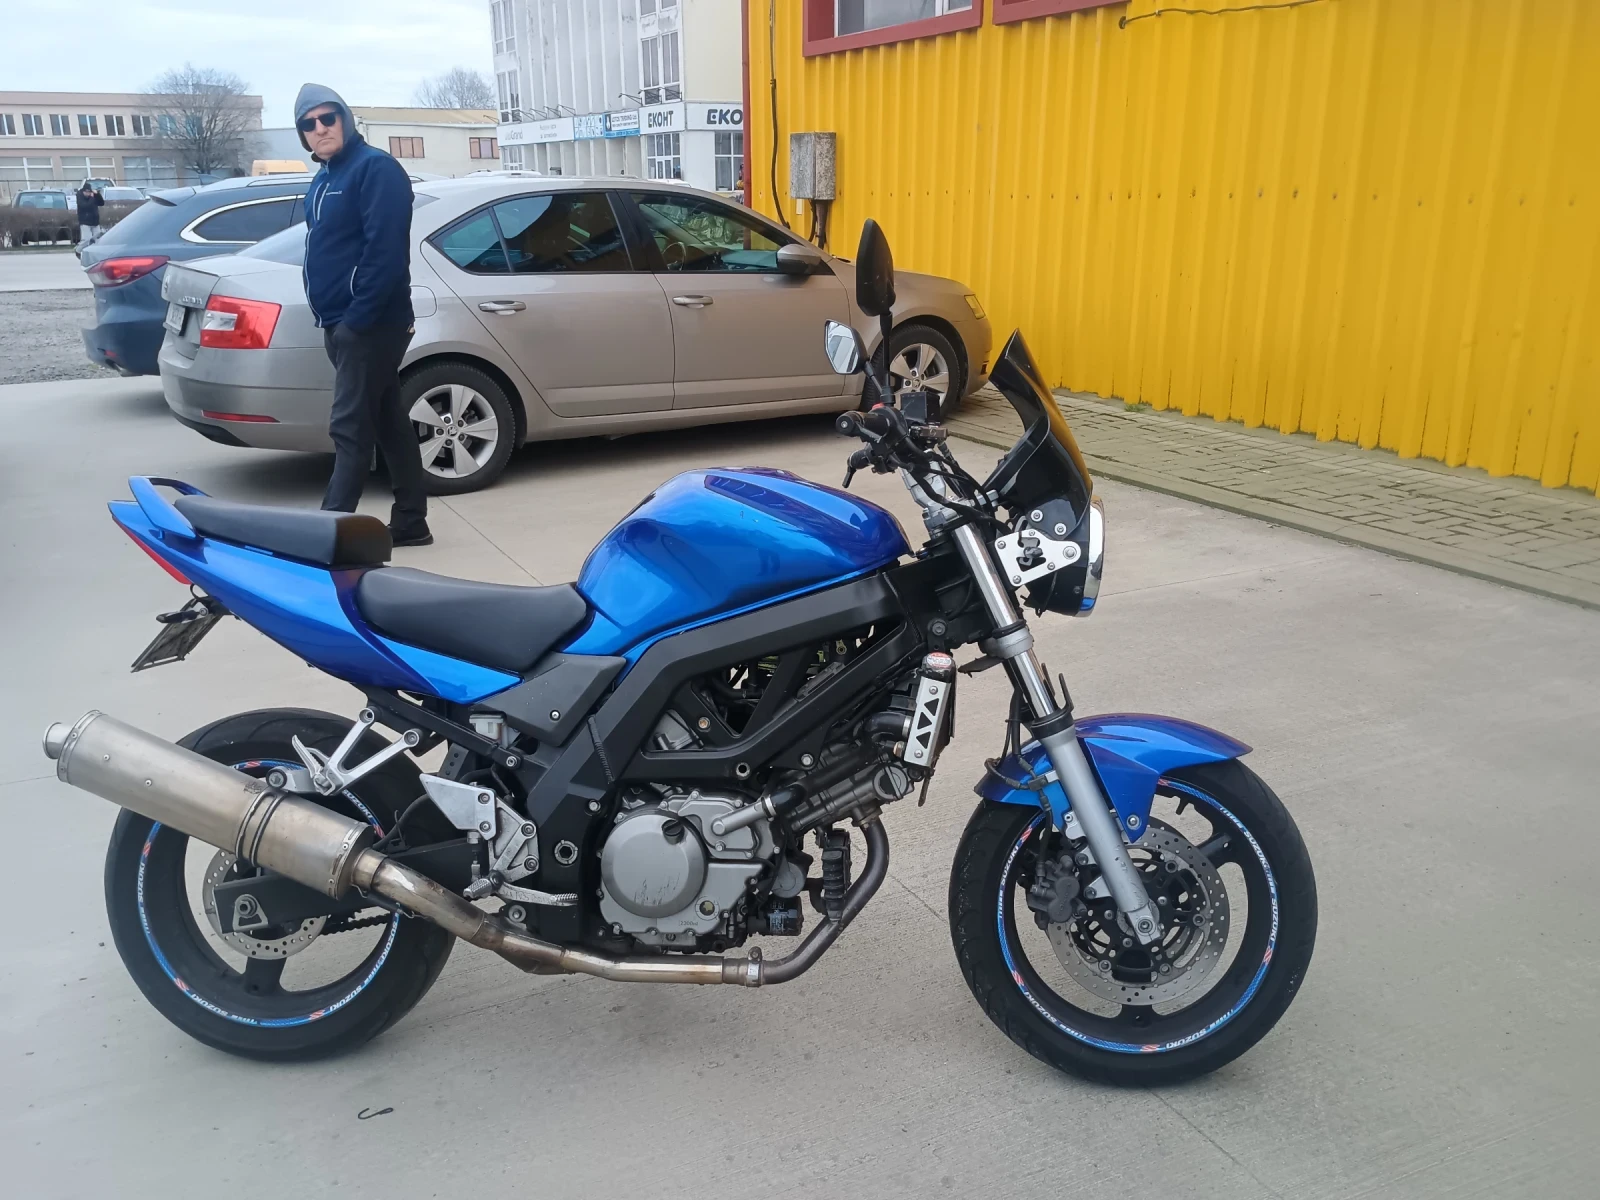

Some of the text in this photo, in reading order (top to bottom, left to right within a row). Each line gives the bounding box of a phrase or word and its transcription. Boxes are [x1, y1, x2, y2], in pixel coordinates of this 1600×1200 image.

[648, 110, 674, 128] ЕКОНТ
[341, 787, 373, 820] SUZUKI
[999, 844, 1020, 885] SUZUKI
[138, 861, 146, 902] SUZUKI
[1270, 897, 1279, 941] SUZUKI
[190, 992, 228, 1017] SUZUKI
[327, 984, 363, 1012] SUZUKI
[1022, 989, 1057, 1024] SUZUKI
[1164, 1028, 1208, 1048] SUZUKI
